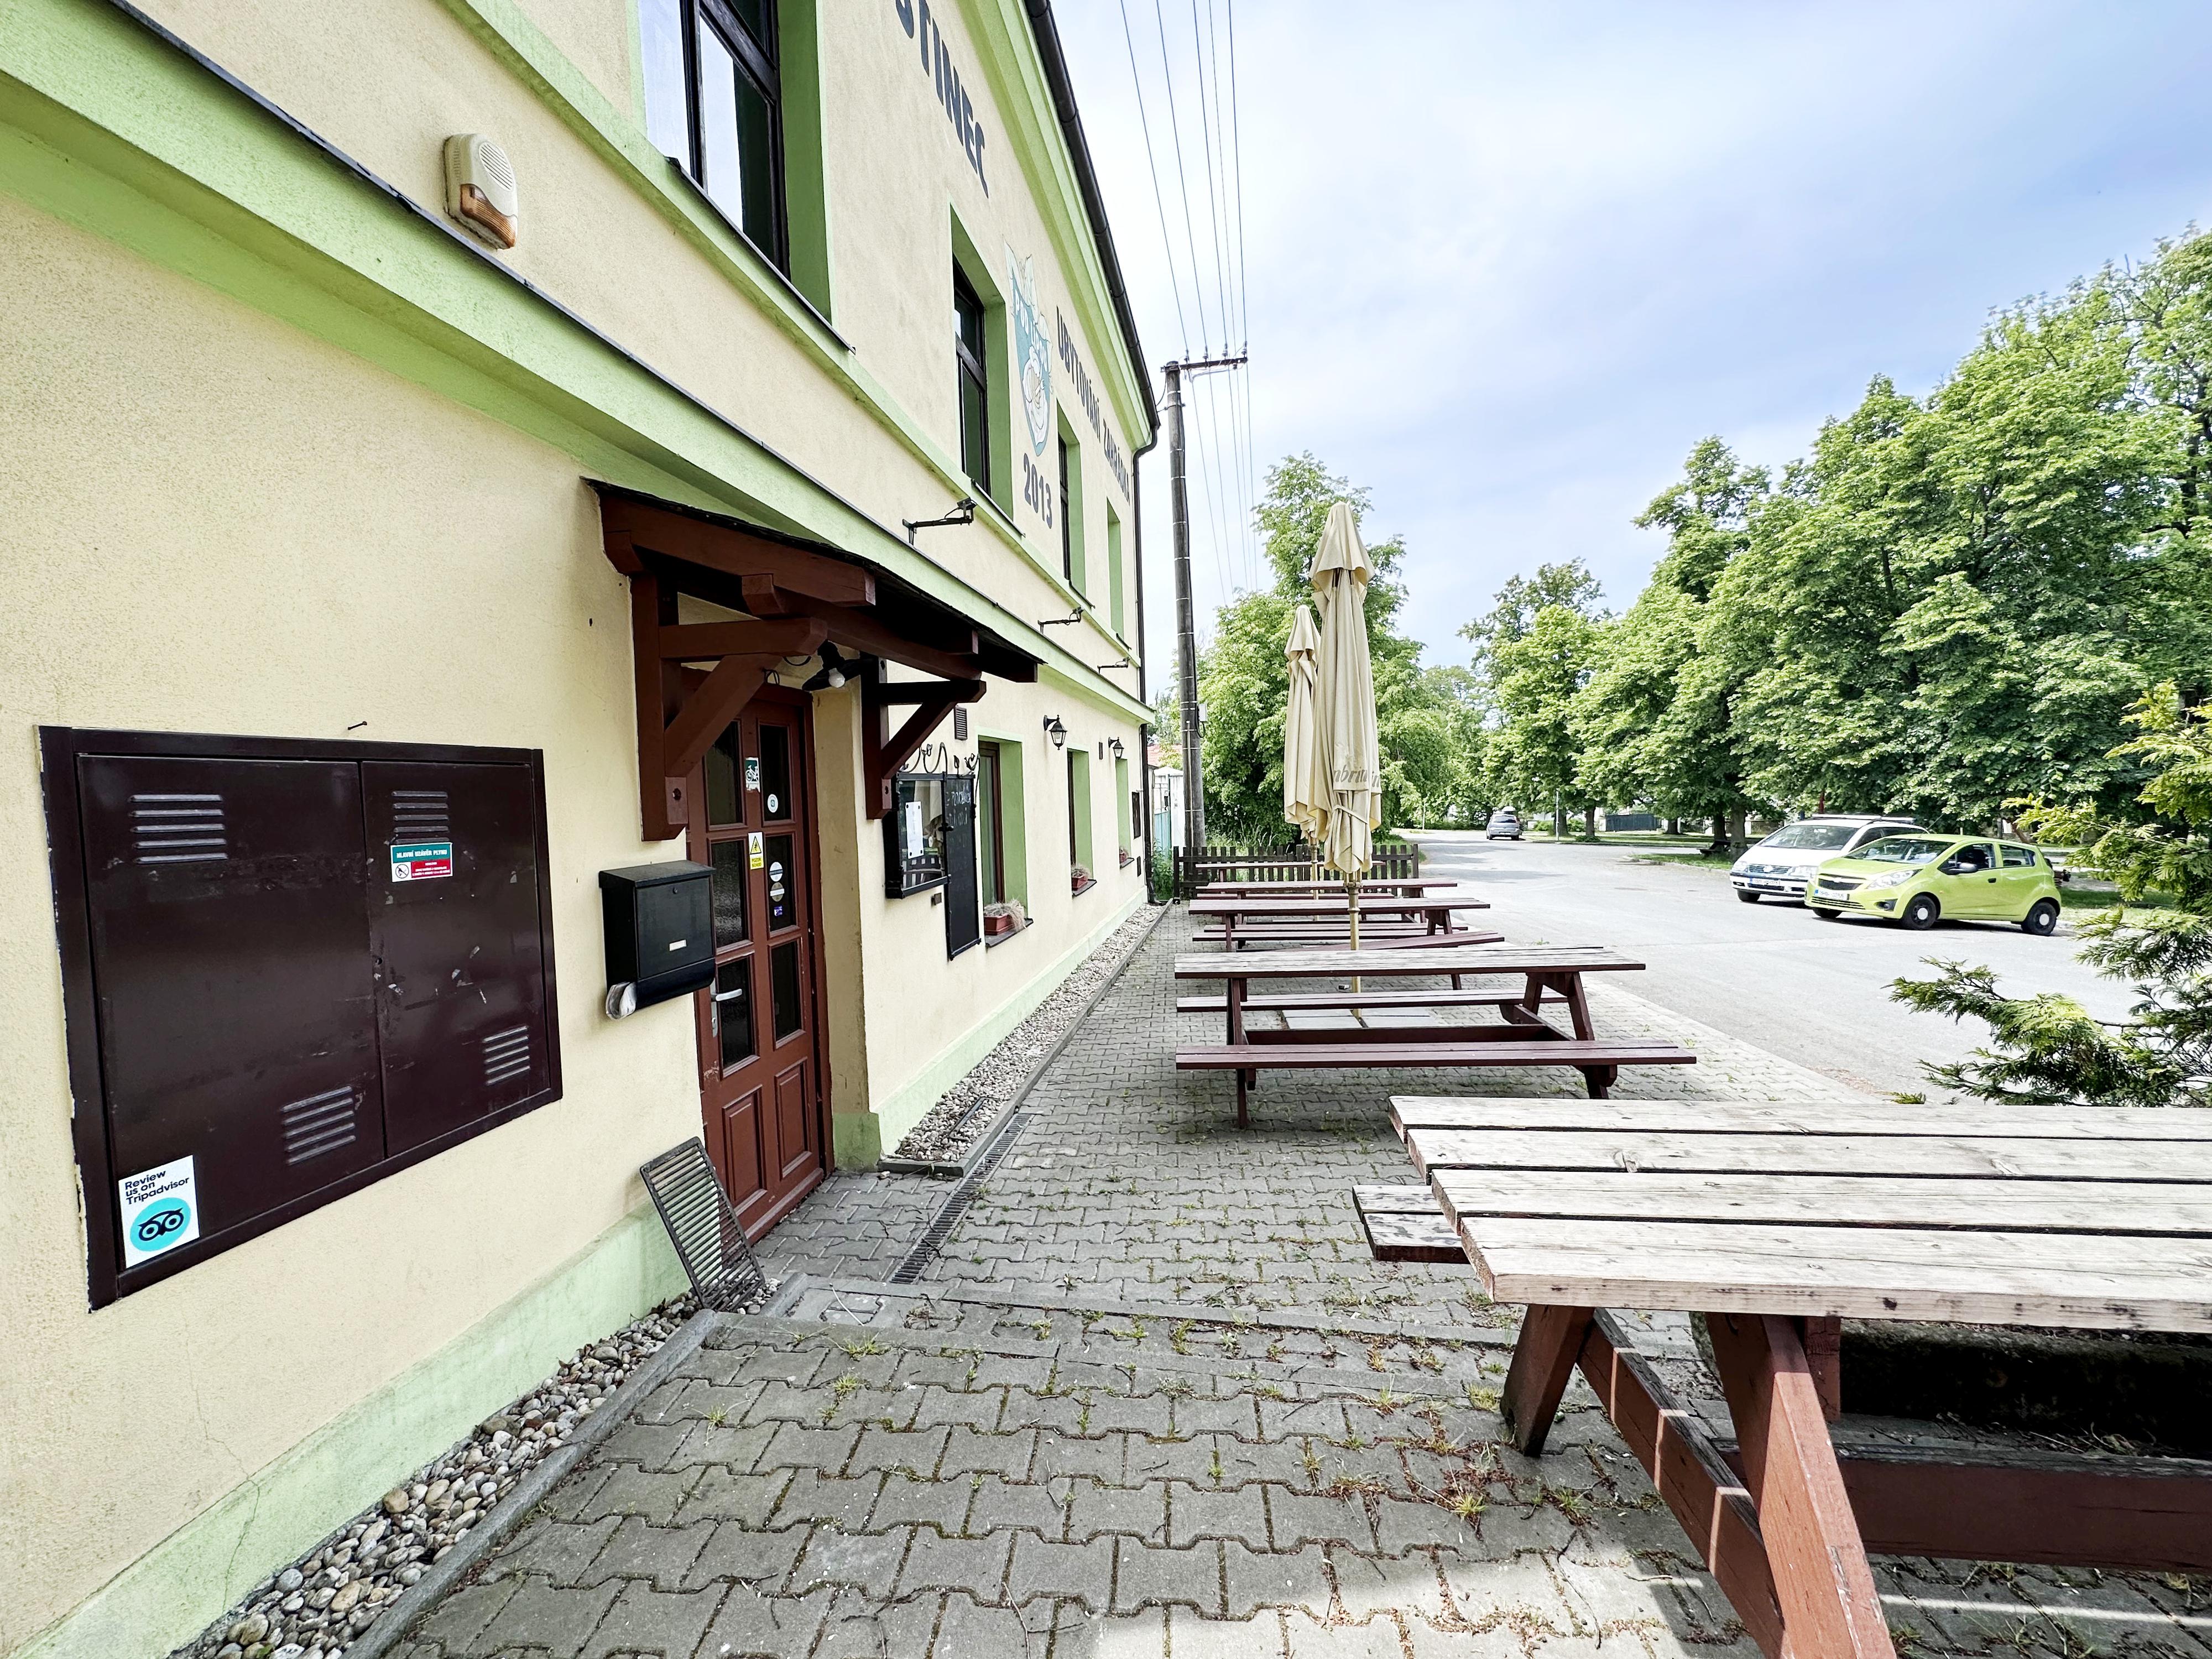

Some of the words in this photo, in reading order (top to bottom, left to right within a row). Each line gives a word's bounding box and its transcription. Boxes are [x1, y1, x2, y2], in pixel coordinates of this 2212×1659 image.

[1024, 453, 1052, 529] 2013
[125, 1171, 166, 1190] Review
[126, 1188, 138, 1197] us
[141, 1182, 155, 1191] on
[126, 1177, 190, 1205] Tripadvisor
